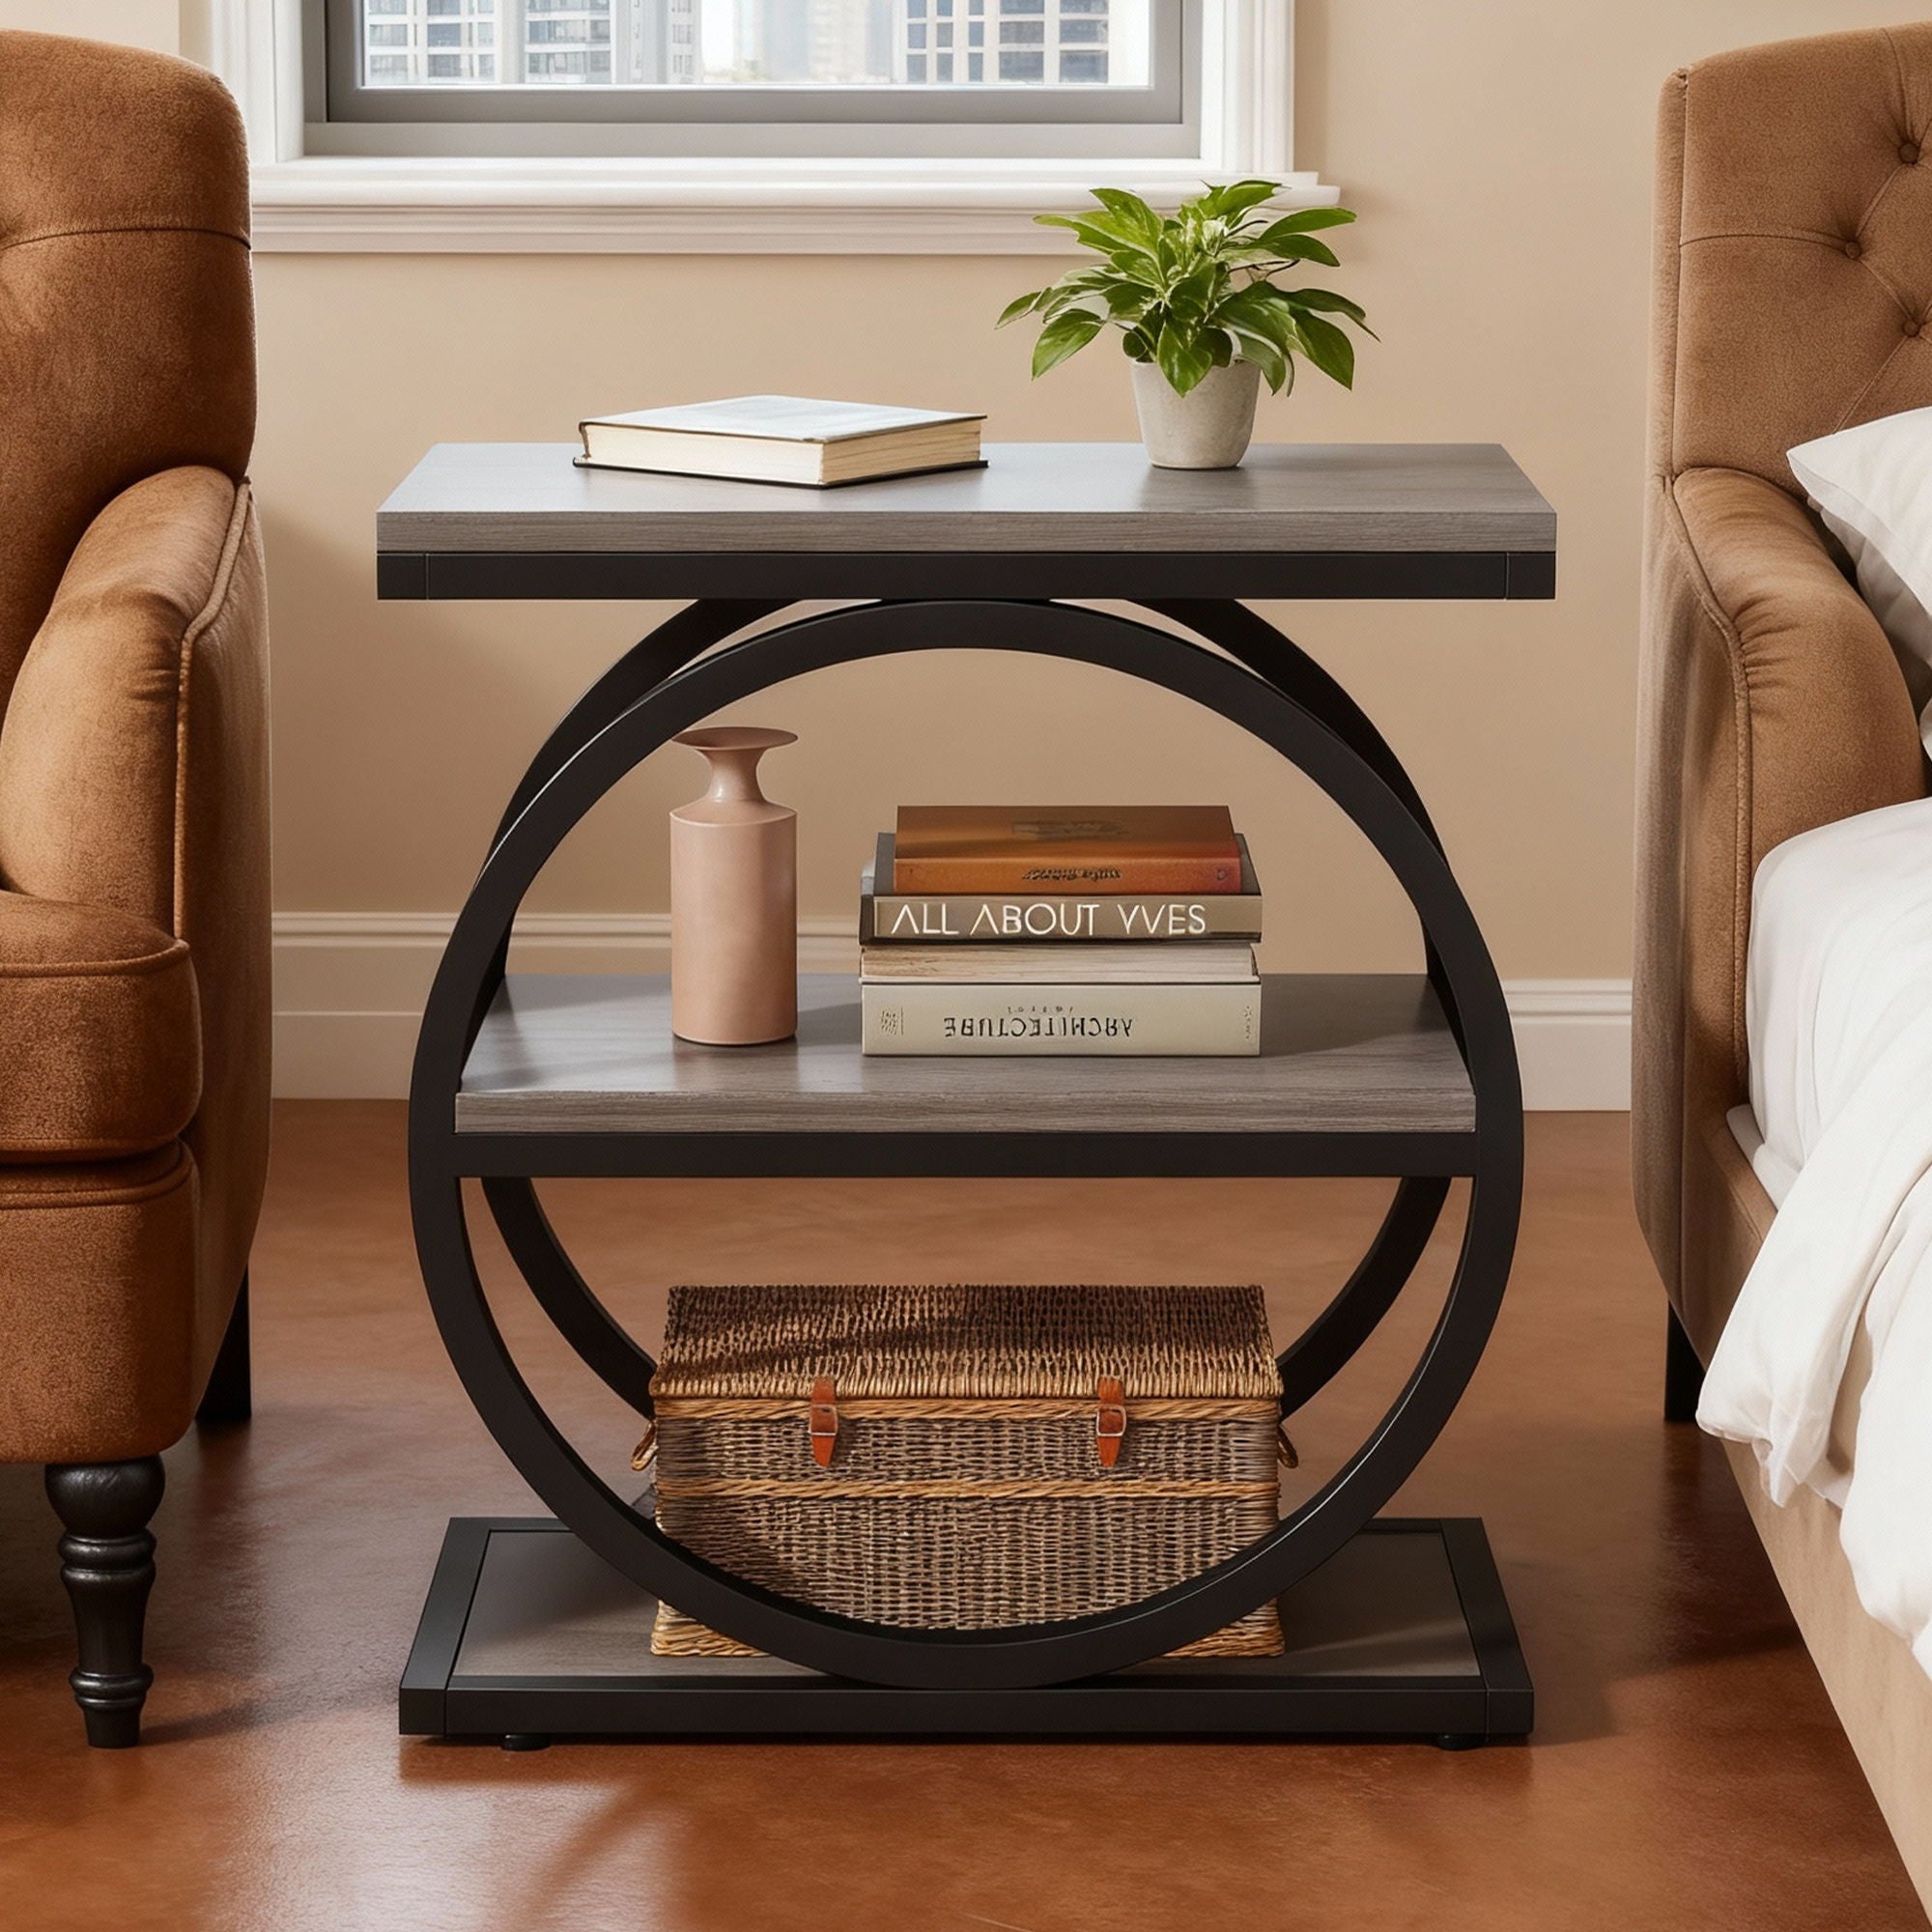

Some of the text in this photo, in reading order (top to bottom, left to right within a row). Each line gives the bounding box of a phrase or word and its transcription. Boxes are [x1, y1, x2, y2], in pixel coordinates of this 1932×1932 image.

[891, 903, 1206, 935] ALL ABOUT YVES
